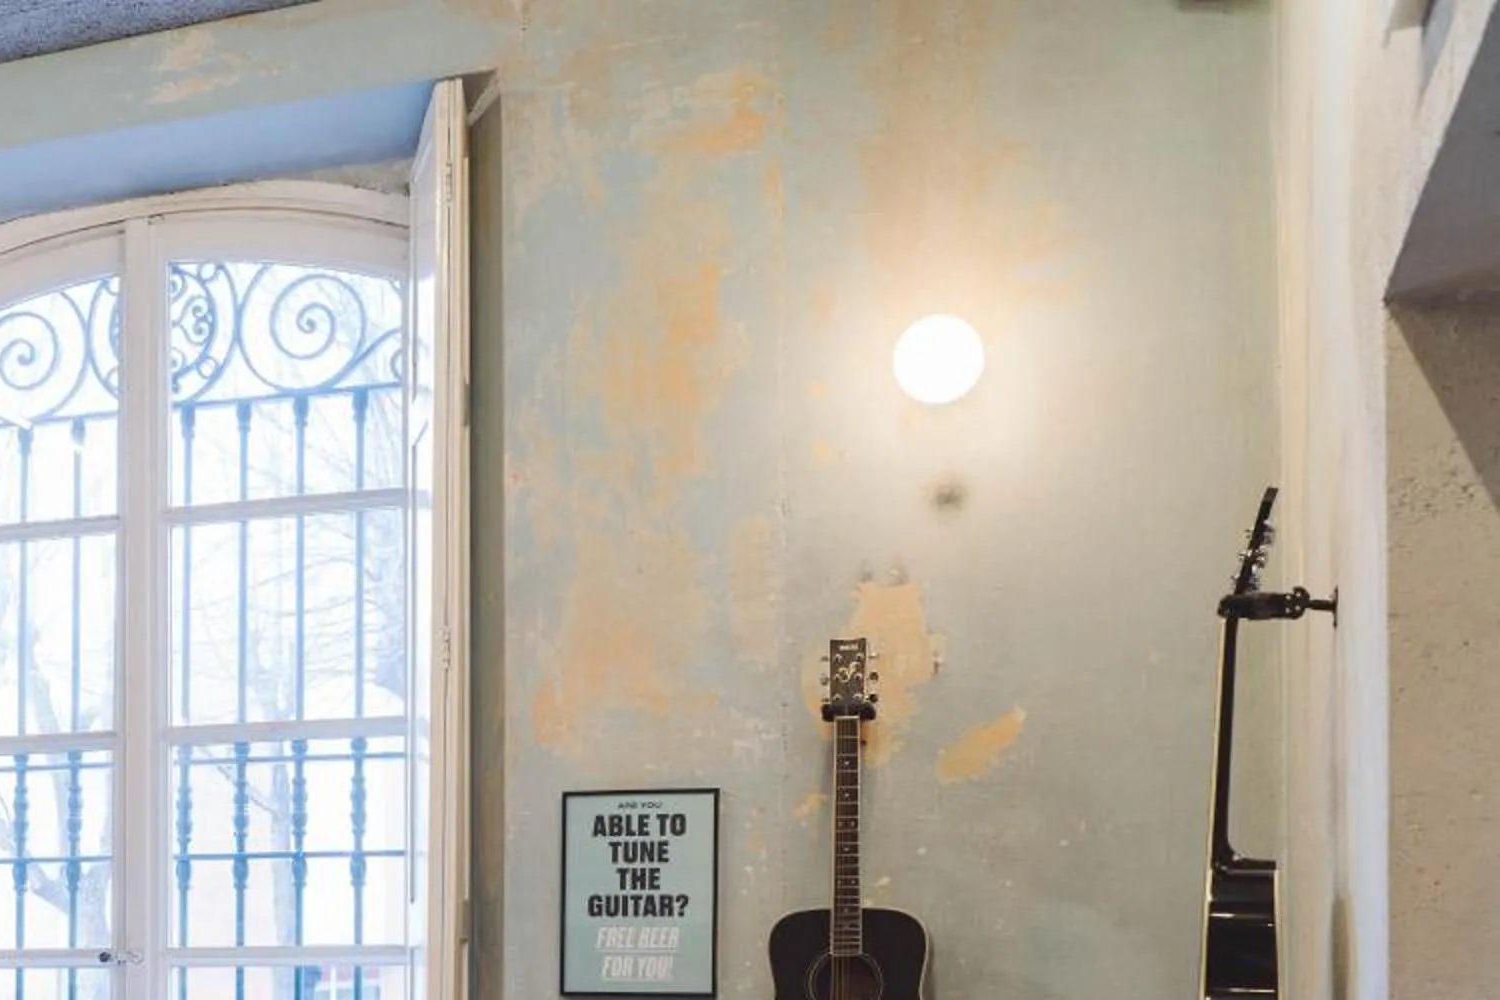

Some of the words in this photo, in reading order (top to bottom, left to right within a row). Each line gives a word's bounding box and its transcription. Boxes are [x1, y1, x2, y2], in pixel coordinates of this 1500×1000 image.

[641, 801, 663, 809] YOU
[592, 813, 650, 837] ABLE
[656, 813, 687, 837] TO
[608, 840, 669, 863] TUNE
[616, 867, 660, 890] THE
[587, 894, 689, 917] GUITAR?
[596, 926, 635, 949] FREE
[638, 926, 679, 949] BEER
[601, 956, 633, 977] FOR
